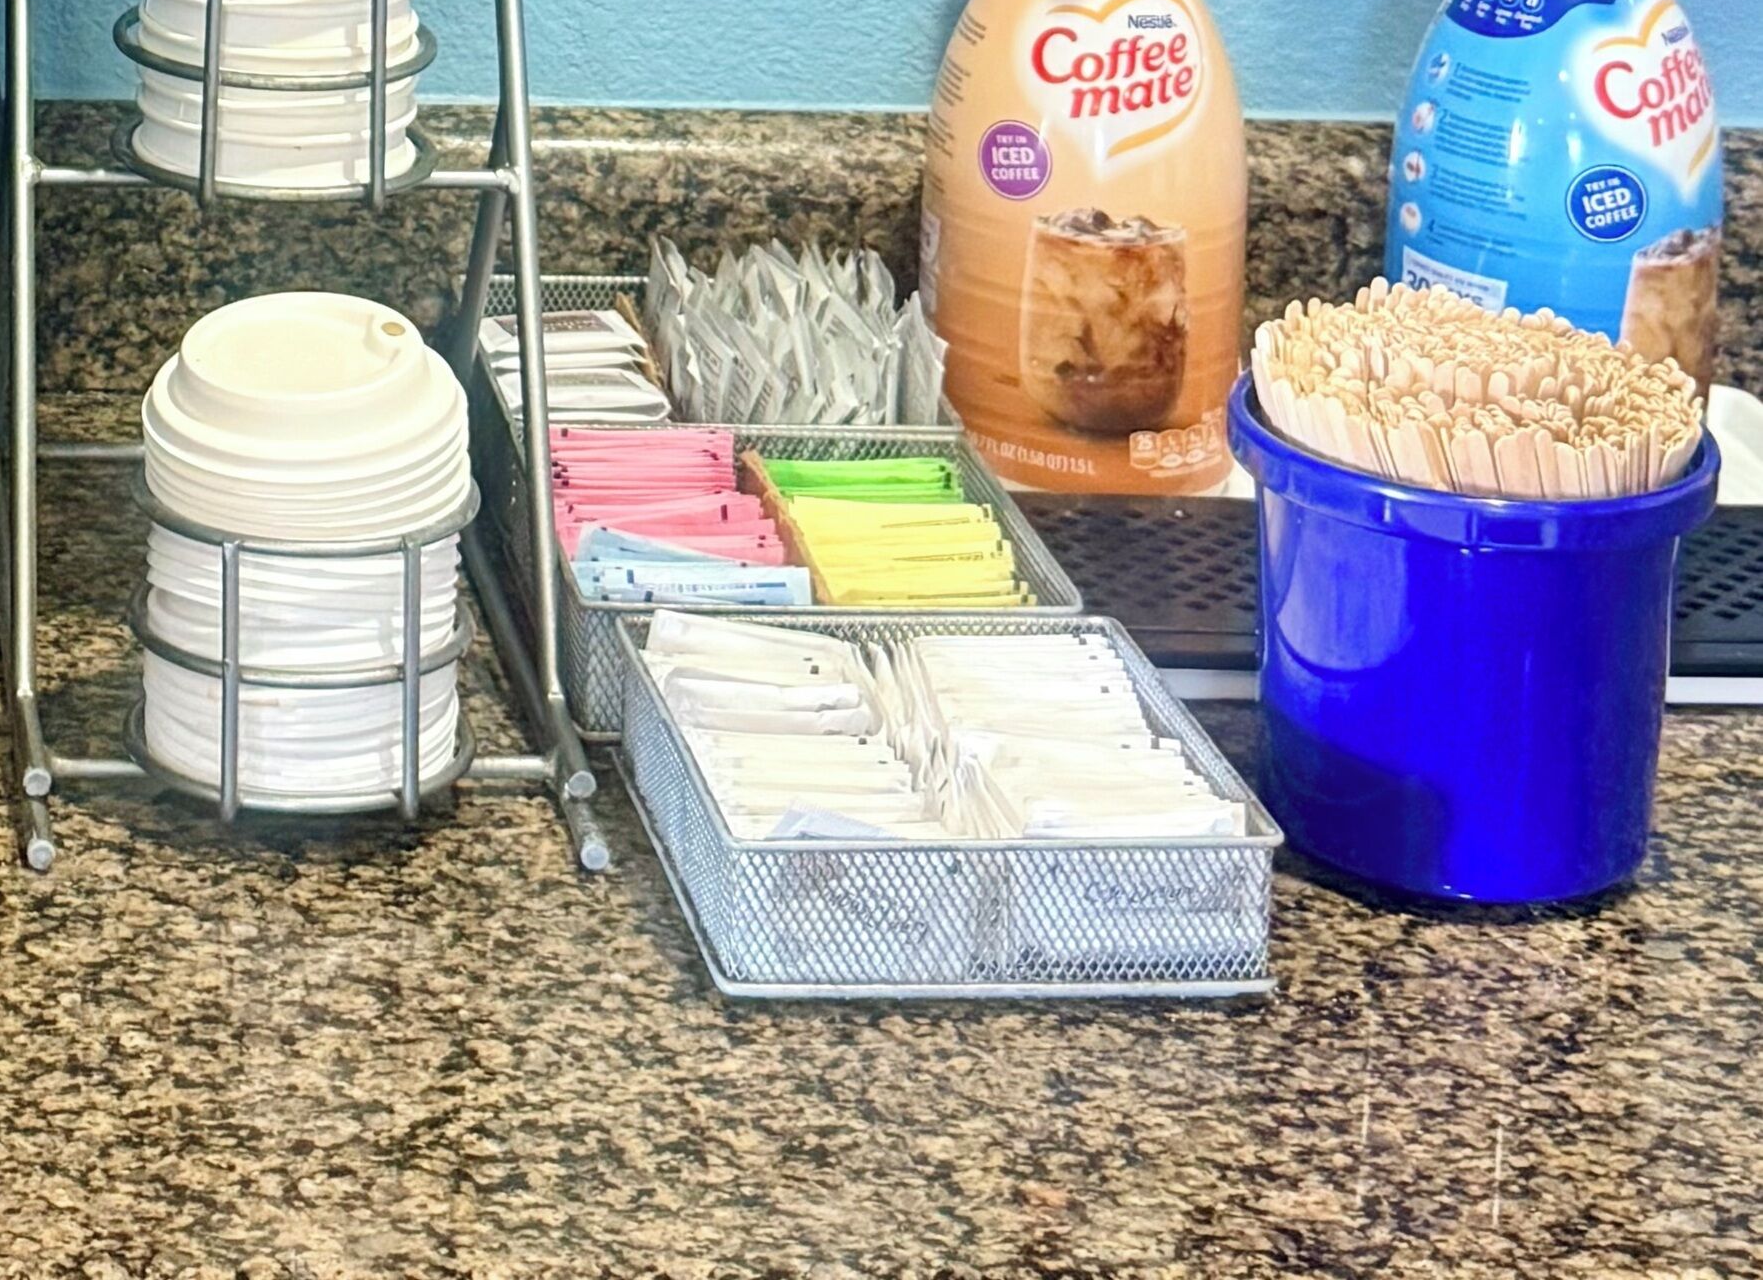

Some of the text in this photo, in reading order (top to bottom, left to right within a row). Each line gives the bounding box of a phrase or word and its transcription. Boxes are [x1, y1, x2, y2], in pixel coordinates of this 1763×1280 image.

[1031, 27, 1187, 84] Coffee
[1070, 64, 1194, 119] mate
[992, 147, 1035, 166] ICED
[991, 166, 1039, 181] COFFEE
[1582, 188, 1631, 214] ICED
[1585, 205, 1638, 229] COFFEE
